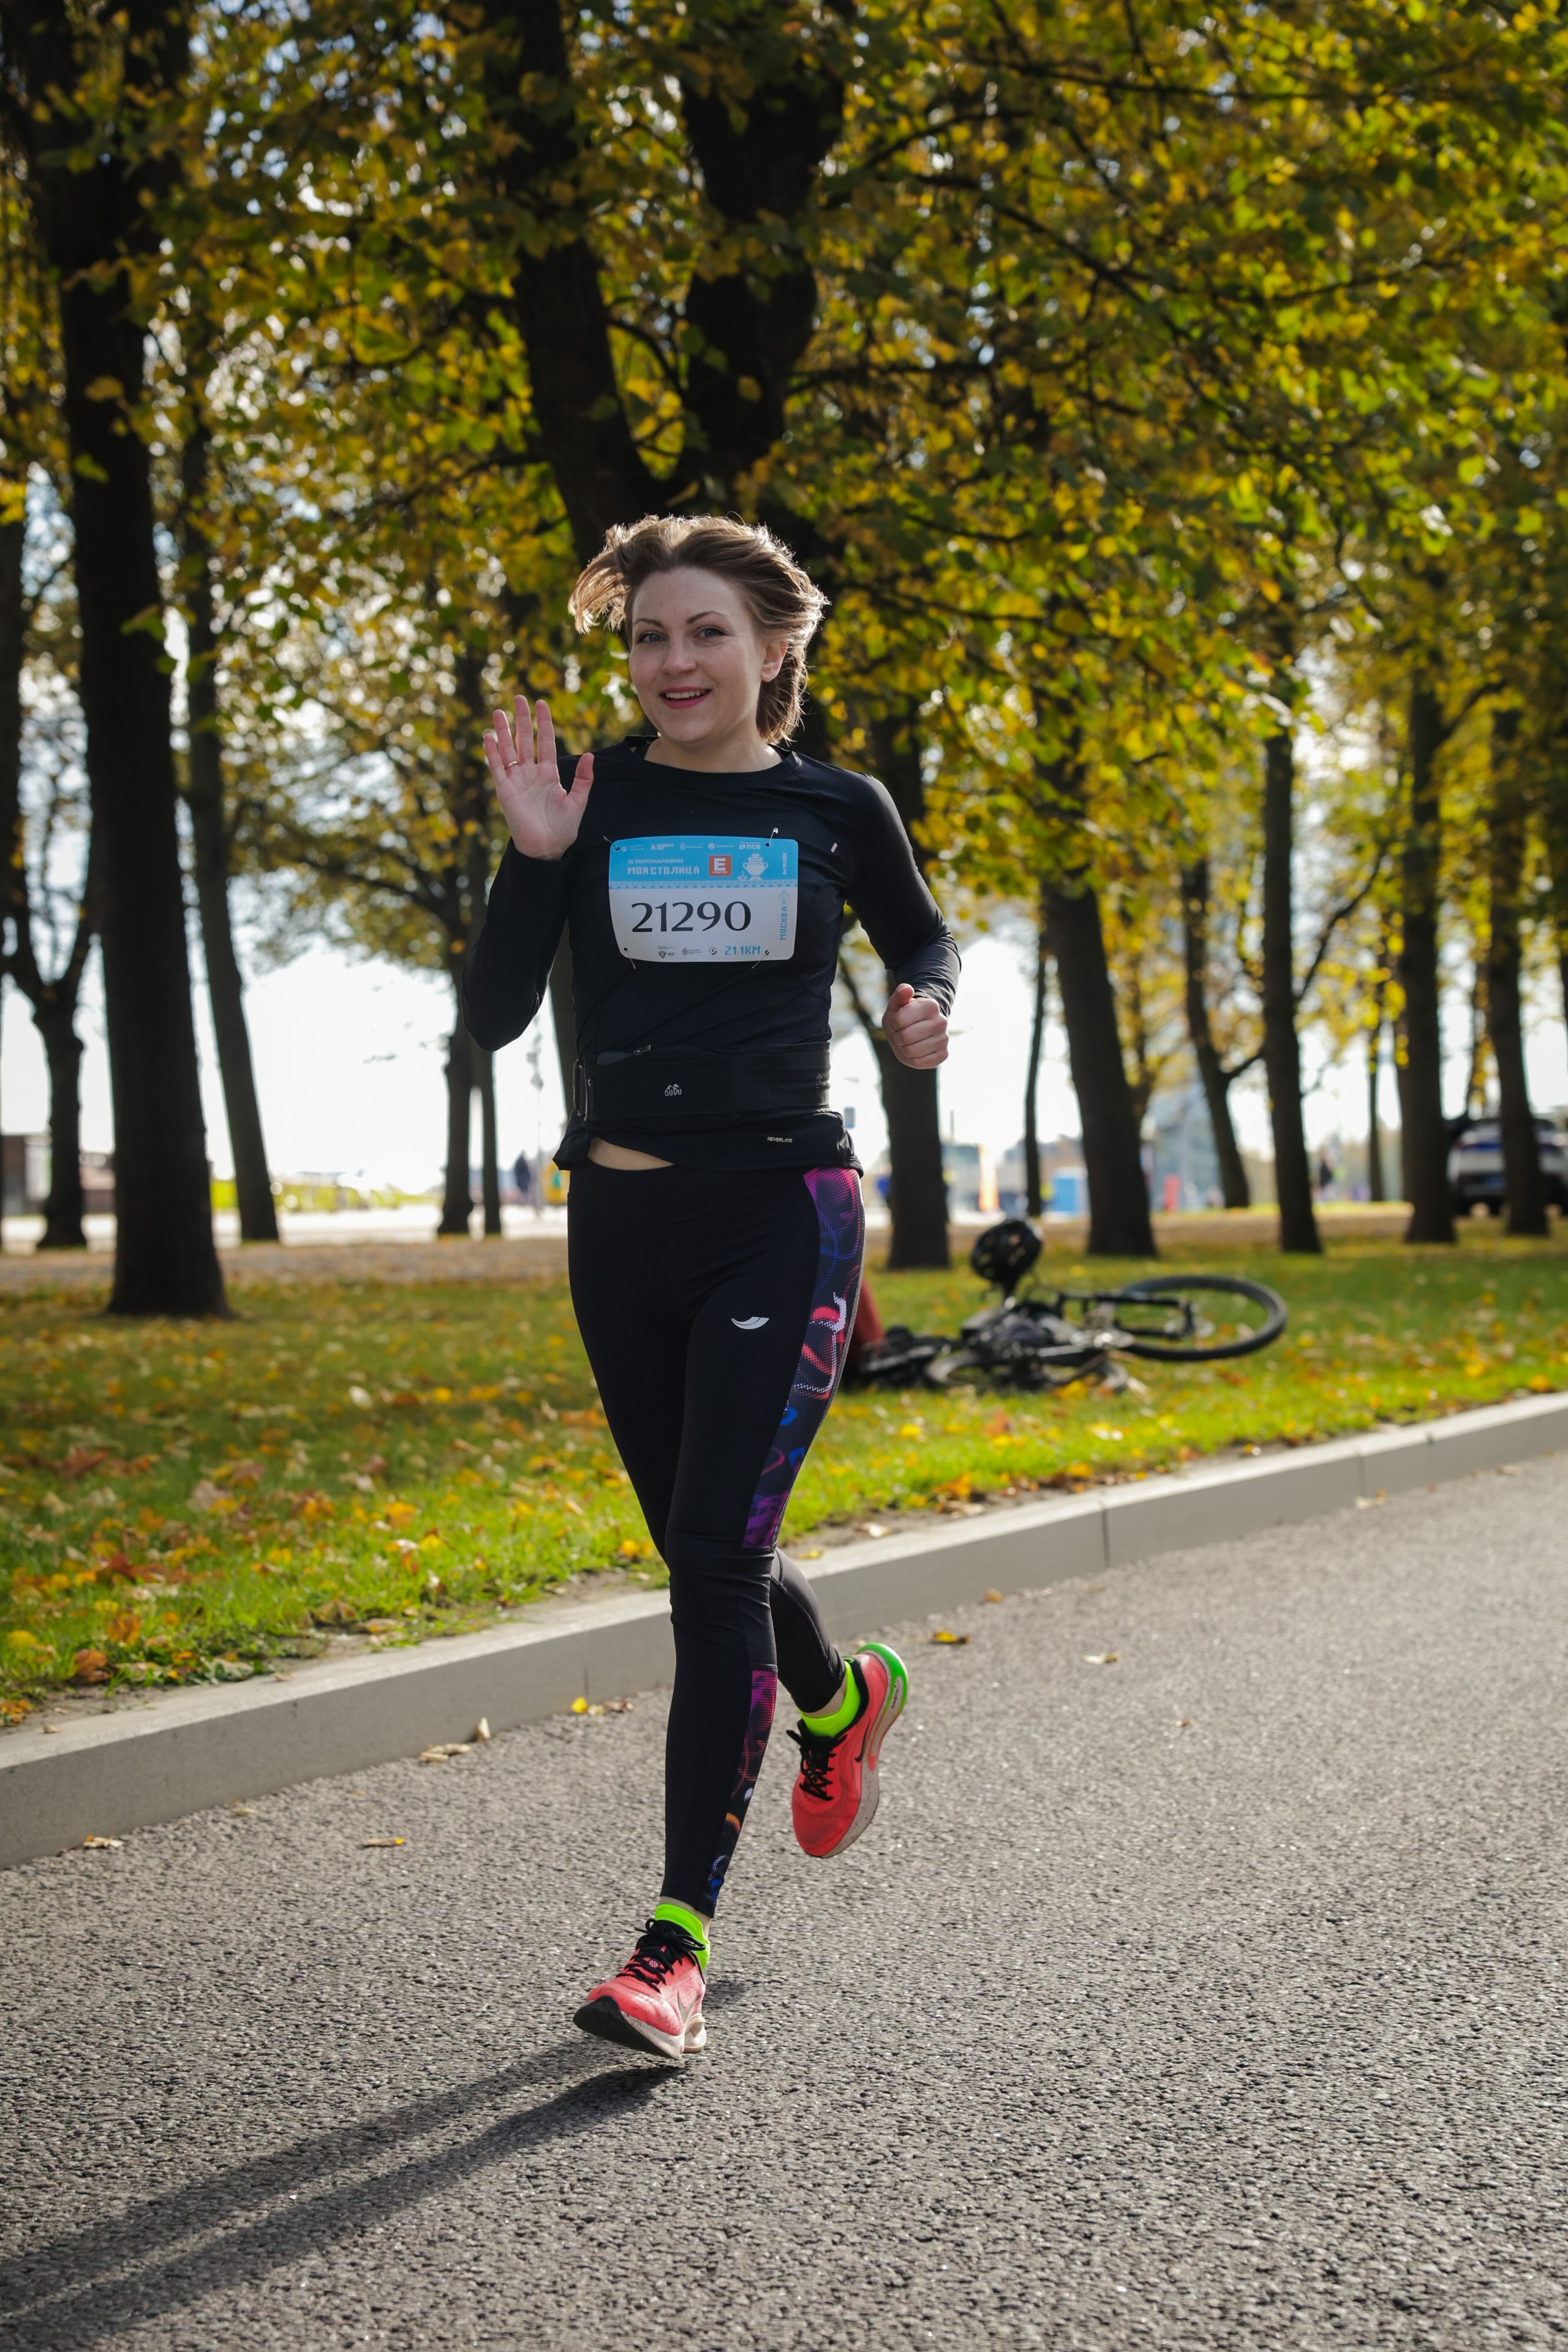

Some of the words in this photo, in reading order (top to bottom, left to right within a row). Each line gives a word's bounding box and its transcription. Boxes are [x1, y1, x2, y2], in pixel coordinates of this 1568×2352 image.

[628, 867, 649, 875] МОЯ
[650, 867, 699, 875] СТОЛИЦА
[631, 902, 752, 933] 21290
